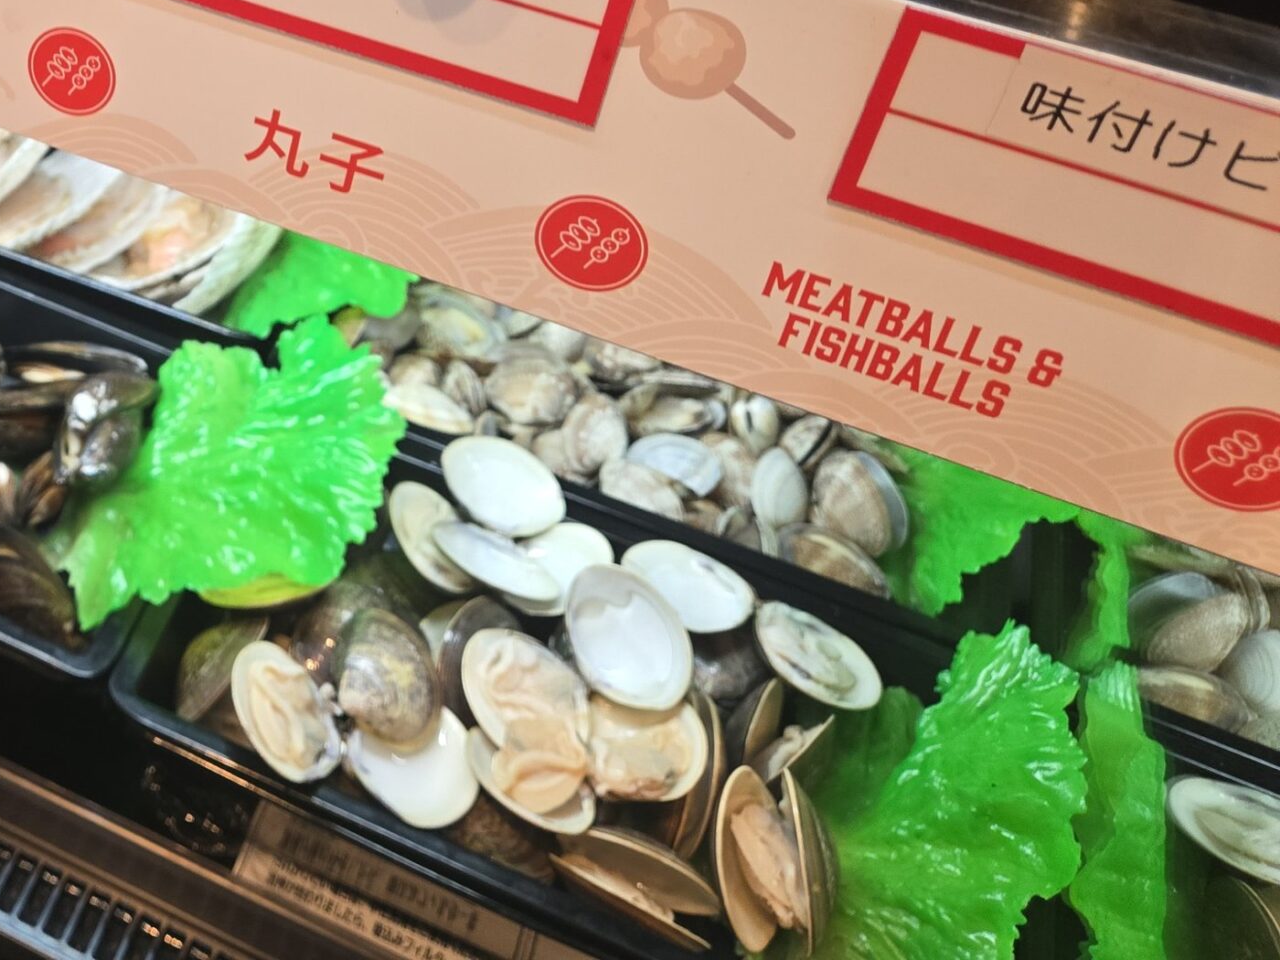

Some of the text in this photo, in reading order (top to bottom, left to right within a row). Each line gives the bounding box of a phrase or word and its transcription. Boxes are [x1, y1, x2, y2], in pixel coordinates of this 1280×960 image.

[243, 108, 386, 195] 丸子
[761, 260, 1064, 388] MEATBALLS &
[777, 312, 1012, 418] FISHBALLS
